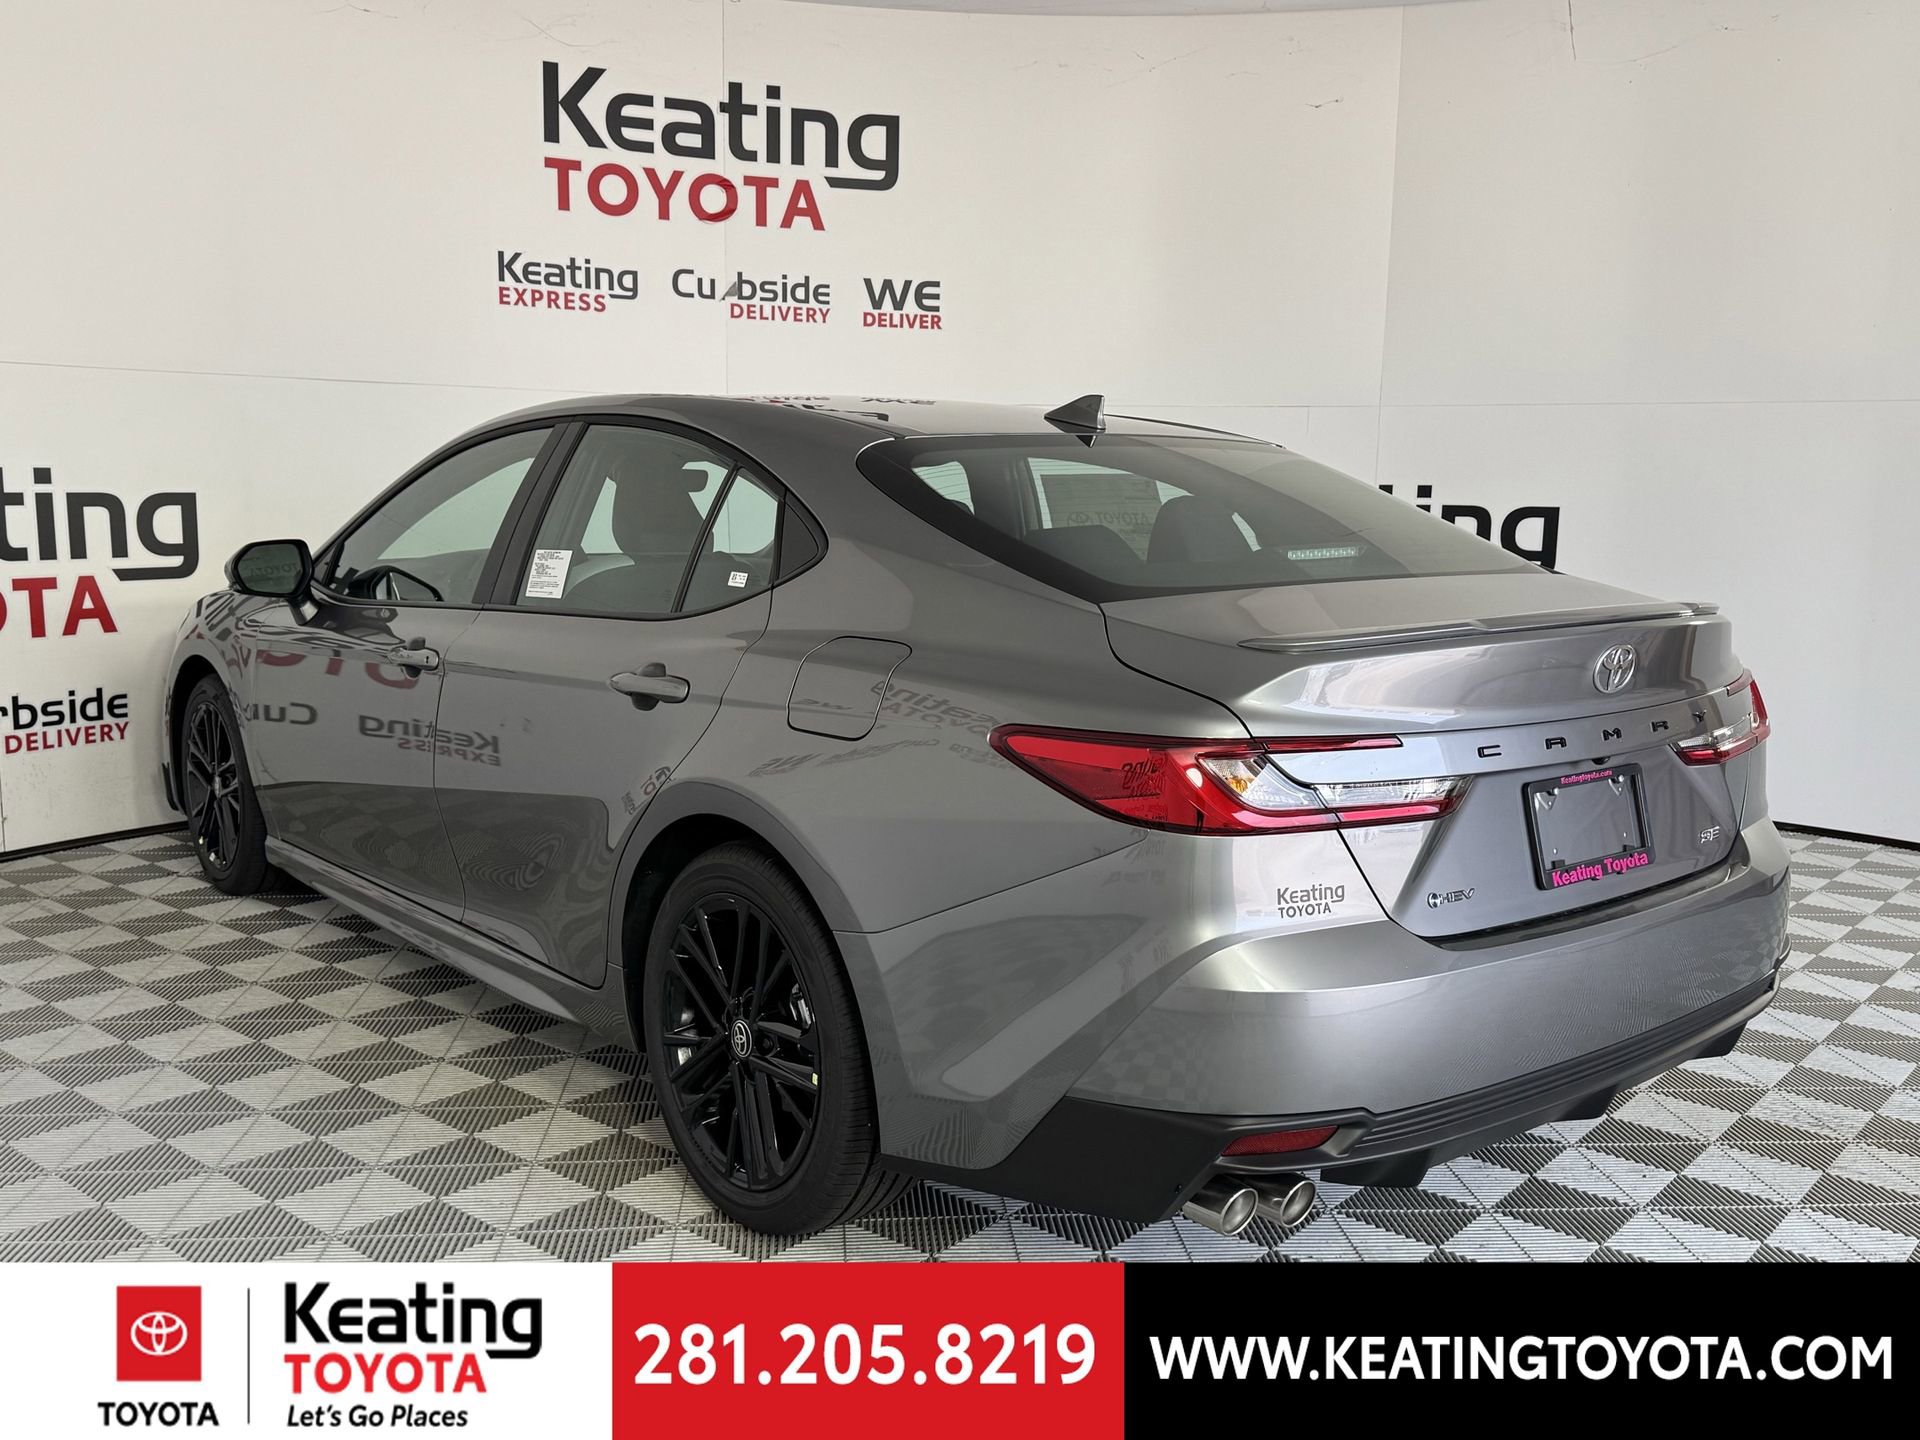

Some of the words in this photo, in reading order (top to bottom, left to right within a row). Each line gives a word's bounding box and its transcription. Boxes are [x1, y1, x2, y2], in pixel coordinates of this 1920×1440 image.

[542, 60, 900, 191] Keating
[543, 156, 826, 231] TOYOTA
[497, 250, 639, 300] Keating
[671, 268, 830, 305] Cubside
[498, 286, 607, 313] EXPRESS
[863, 277, 941, 312] WE
[729, 303, 831, 324] DELIVERY
[862, 311, 943, 330] DELIVER
[1378, 484, 1560, 570] ng
[0, 575, 119, 638] TA
[4, 721, 129, 754] DELIVERY
[1477, 708, 1707, 759] CAMRY
[1551, 864, 1603, 888] Keating
[1603, 852, 1649, 874] Toyota
[1277, 885, 1345, 906] Keating
[1278, 902, 1332, 919] TOYOTA
